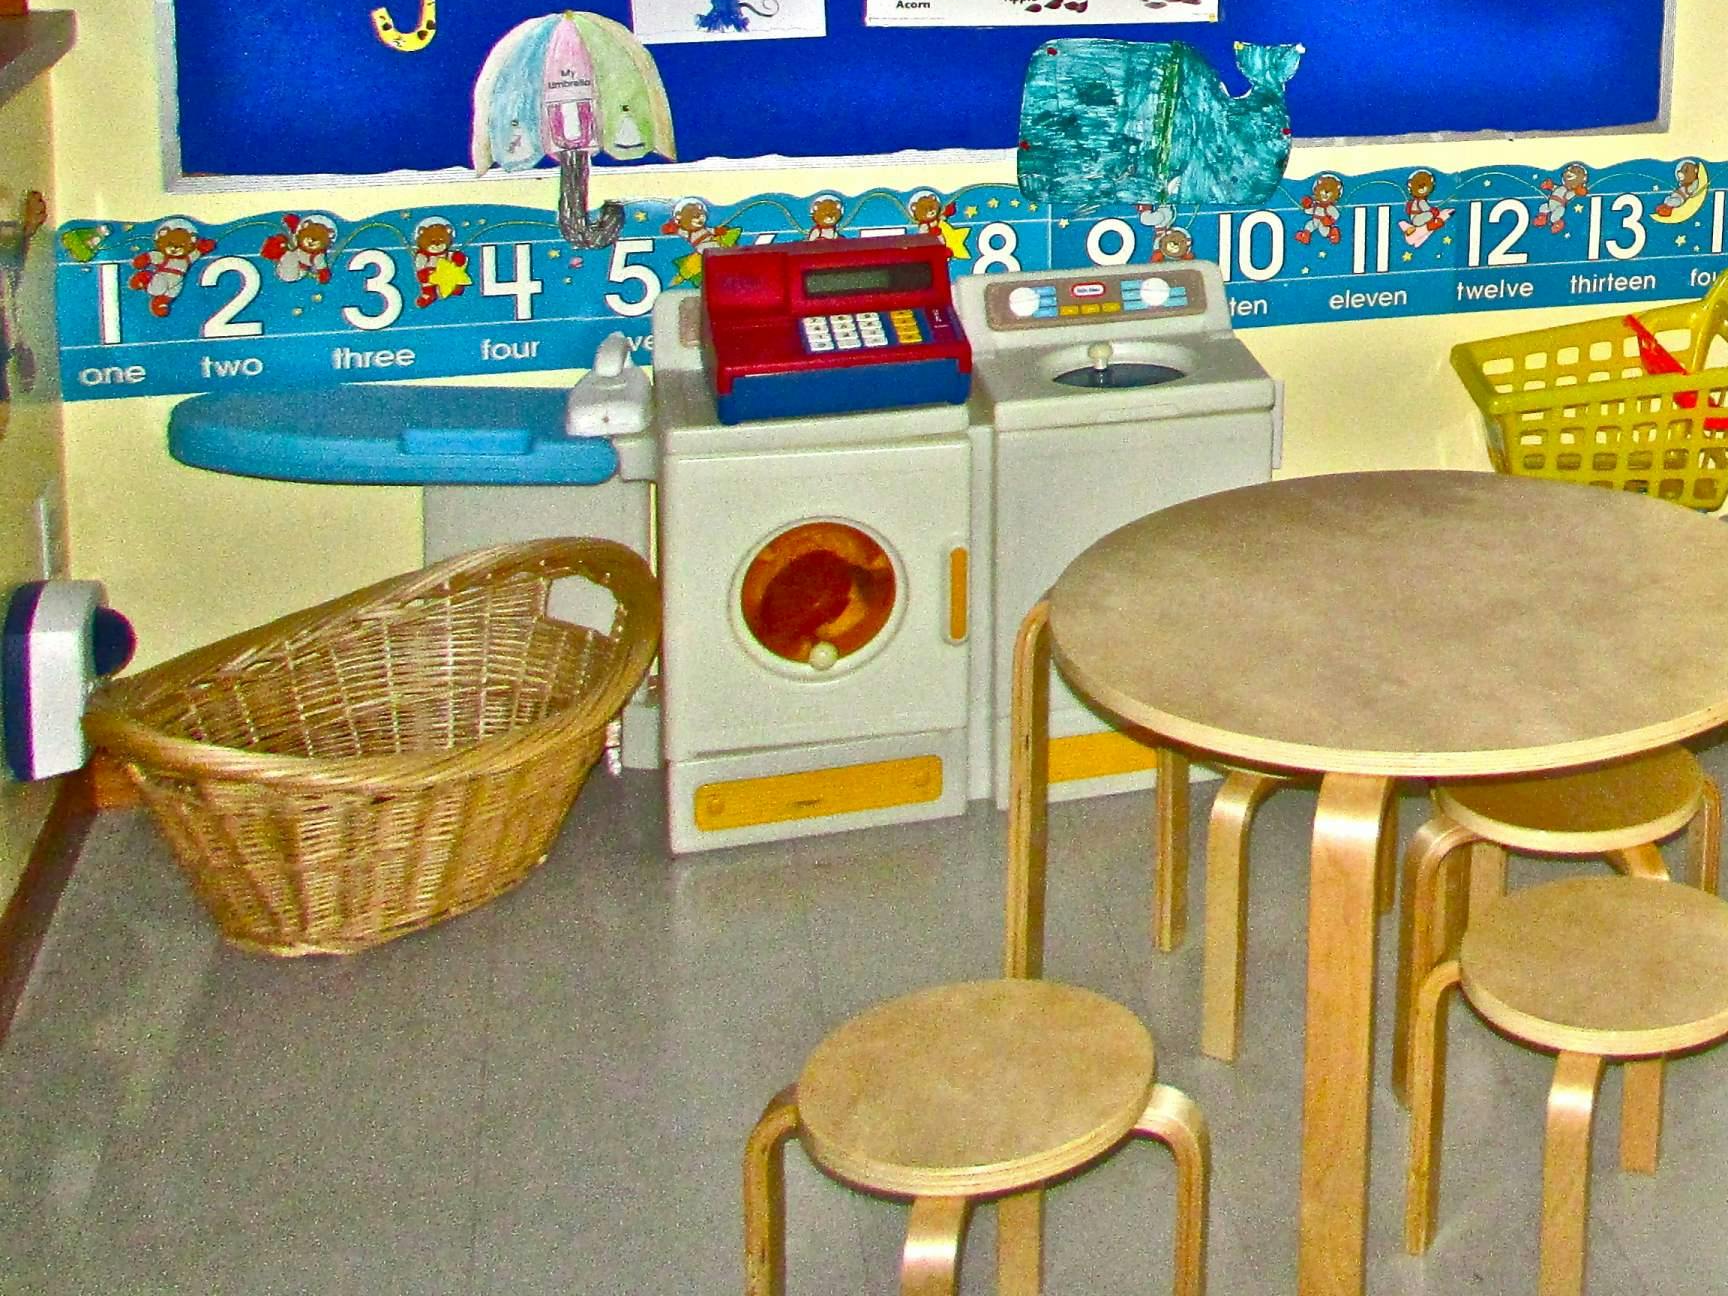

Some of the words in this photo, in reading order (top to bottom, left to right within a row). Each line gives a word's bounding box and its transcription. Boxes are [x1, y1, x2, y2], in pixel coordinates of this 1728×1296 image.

[896, 0, 931, 10] Acorn
[561, 69, 575, 79] My
[548, 79, 592, 90] Umbrella
[98, 262, 121, 345] 1
[201, 255, 264, 339] 2
[343, 249, 403, 331] 3
[481, 244, 544, 320] 4
[605, 238, 661, 317] 5
[972, 222, 1020, 275] 8
[1219, 211, 1284, 281] 10
[1353, 205, 1391, 274] 11
[1467, 198, 1531, 268] 12
[1588, 193, 1647, 260] 13
[80, 363, 146, 387] one
[201, 355, 264, 378] two
[332, 345, 416, 371] three
[480, 336, 541, 361] four
[1229, 296, 1268, 318] ten
[1329, 288, 1407, 311] eleven
[1456, 279, 1534, 302] twelve
[1570, 272, 1657, 294] thirteen
